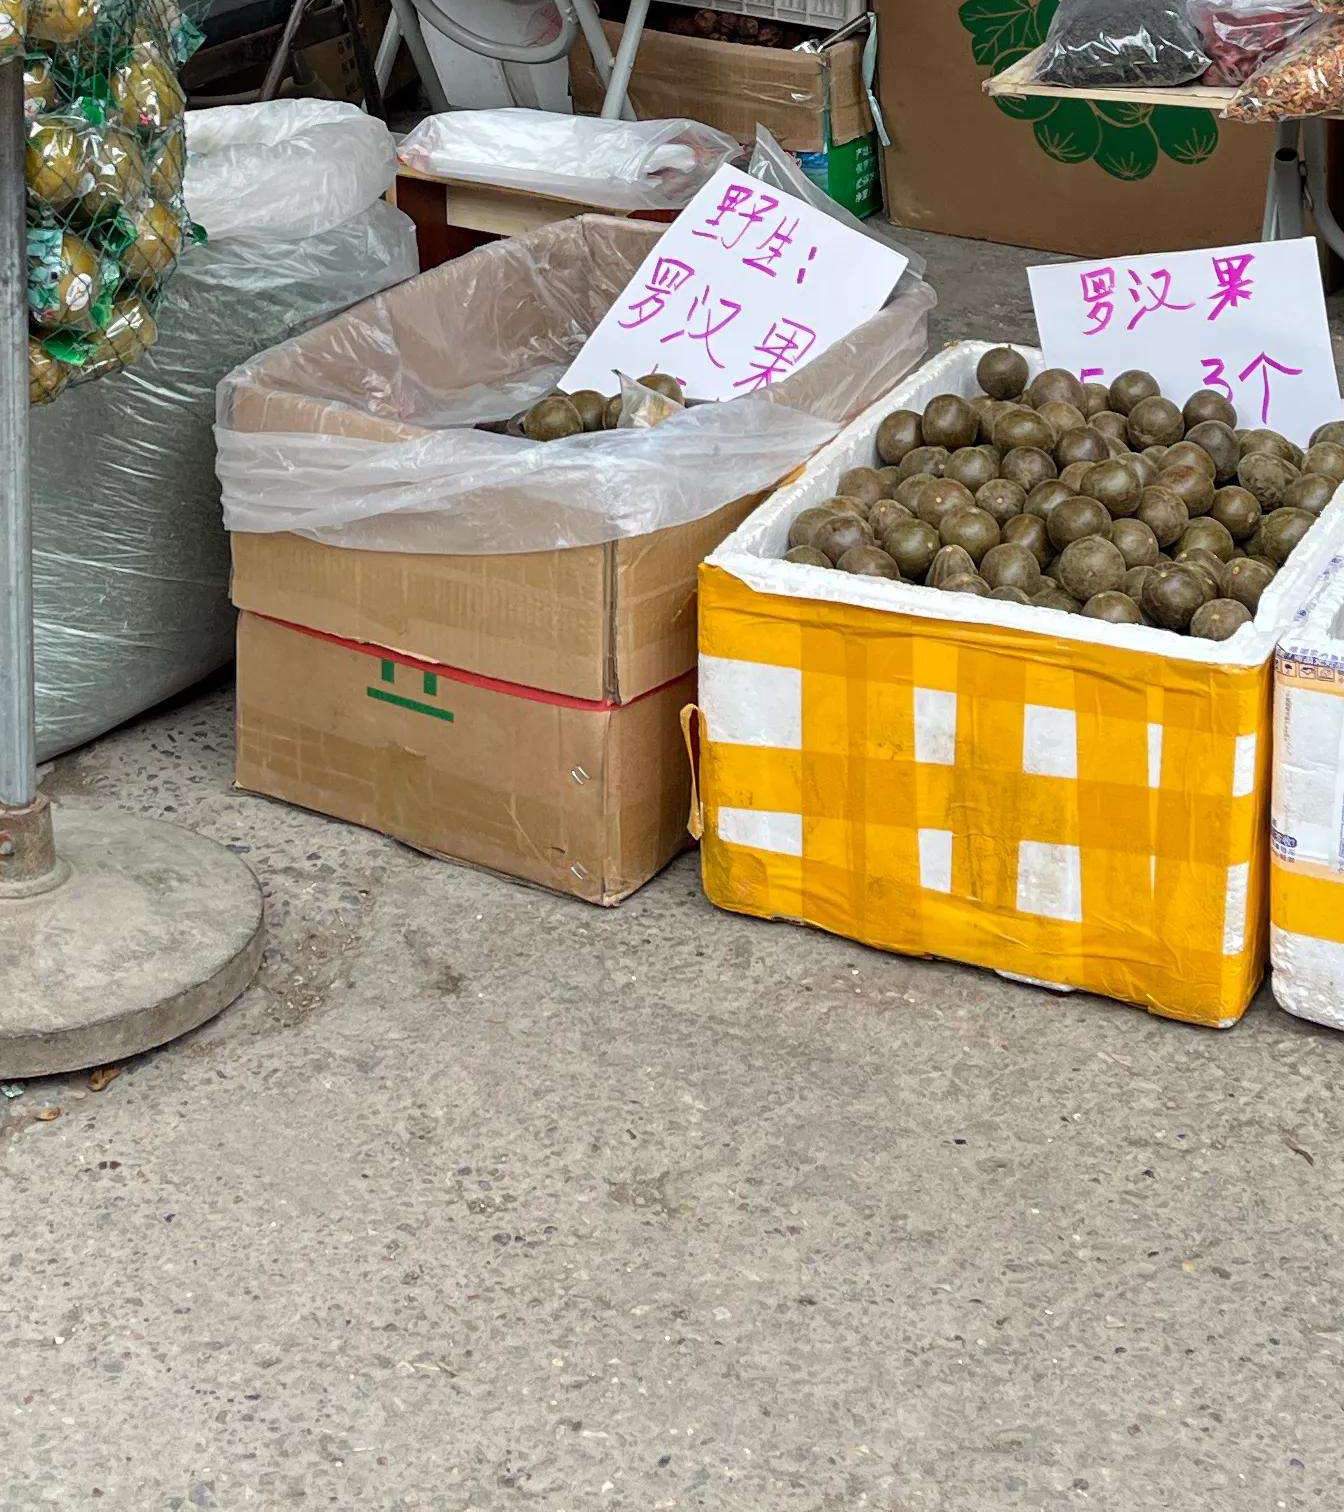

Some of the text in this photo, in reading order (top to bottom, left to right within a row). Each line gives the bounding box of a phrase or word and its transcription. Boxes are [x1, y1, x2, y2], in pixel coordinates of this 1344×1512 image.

[617, 257, 817, 389] 罗汉果
[1080, 254, 1256, 336] 罗汉果
